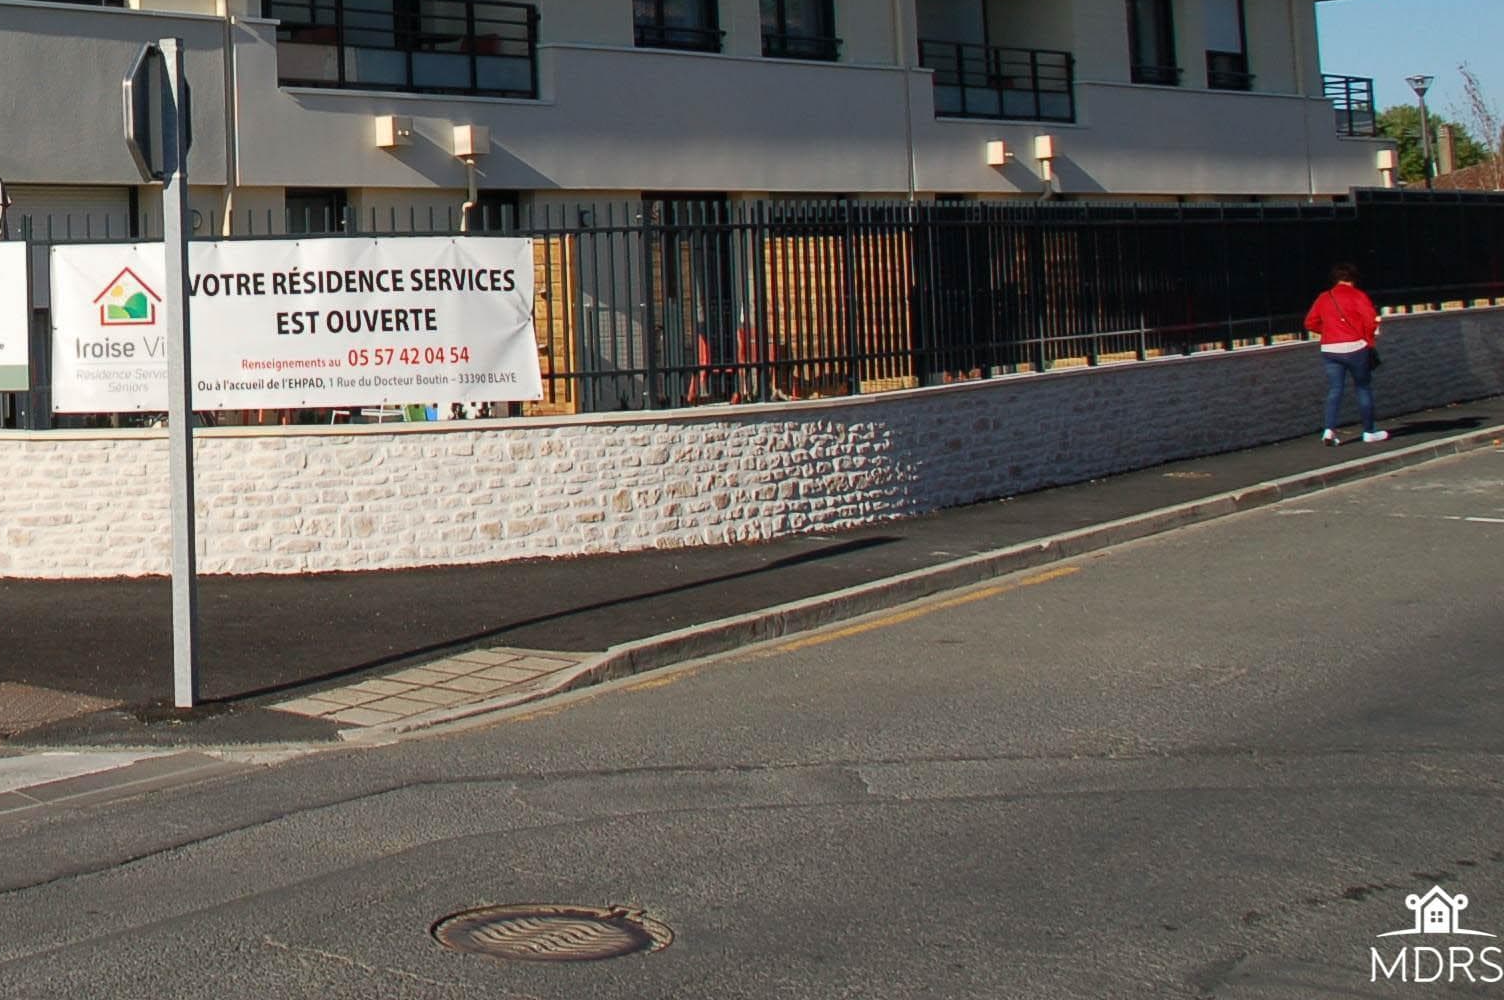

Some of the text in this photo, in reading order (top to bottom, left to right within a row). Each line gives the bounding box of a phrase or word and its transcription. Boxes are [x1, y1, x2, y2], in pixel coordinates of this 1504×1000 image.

[189, 266, 515, 296] VOTRE RÉSIDENCE SERVICES
[276, 308, 438, 335] EST OUVERTE
[76, 336, 166, 359] Iroise Vi
[241, 346, 469, 371] Renseignements au 05 57 42 04 54
[197, 380, 213, 391] Ou
[266, 378, 280, 390] de
[337, 377, 356, 388] Rue
[358, 376, 372, 387] du
[374, 375, 413, 387] Docteur
[416, 374, 449, 385] Boutin
[458, 373, 486, 384] 33390
[488, 372, 517, 384] BLAYE
